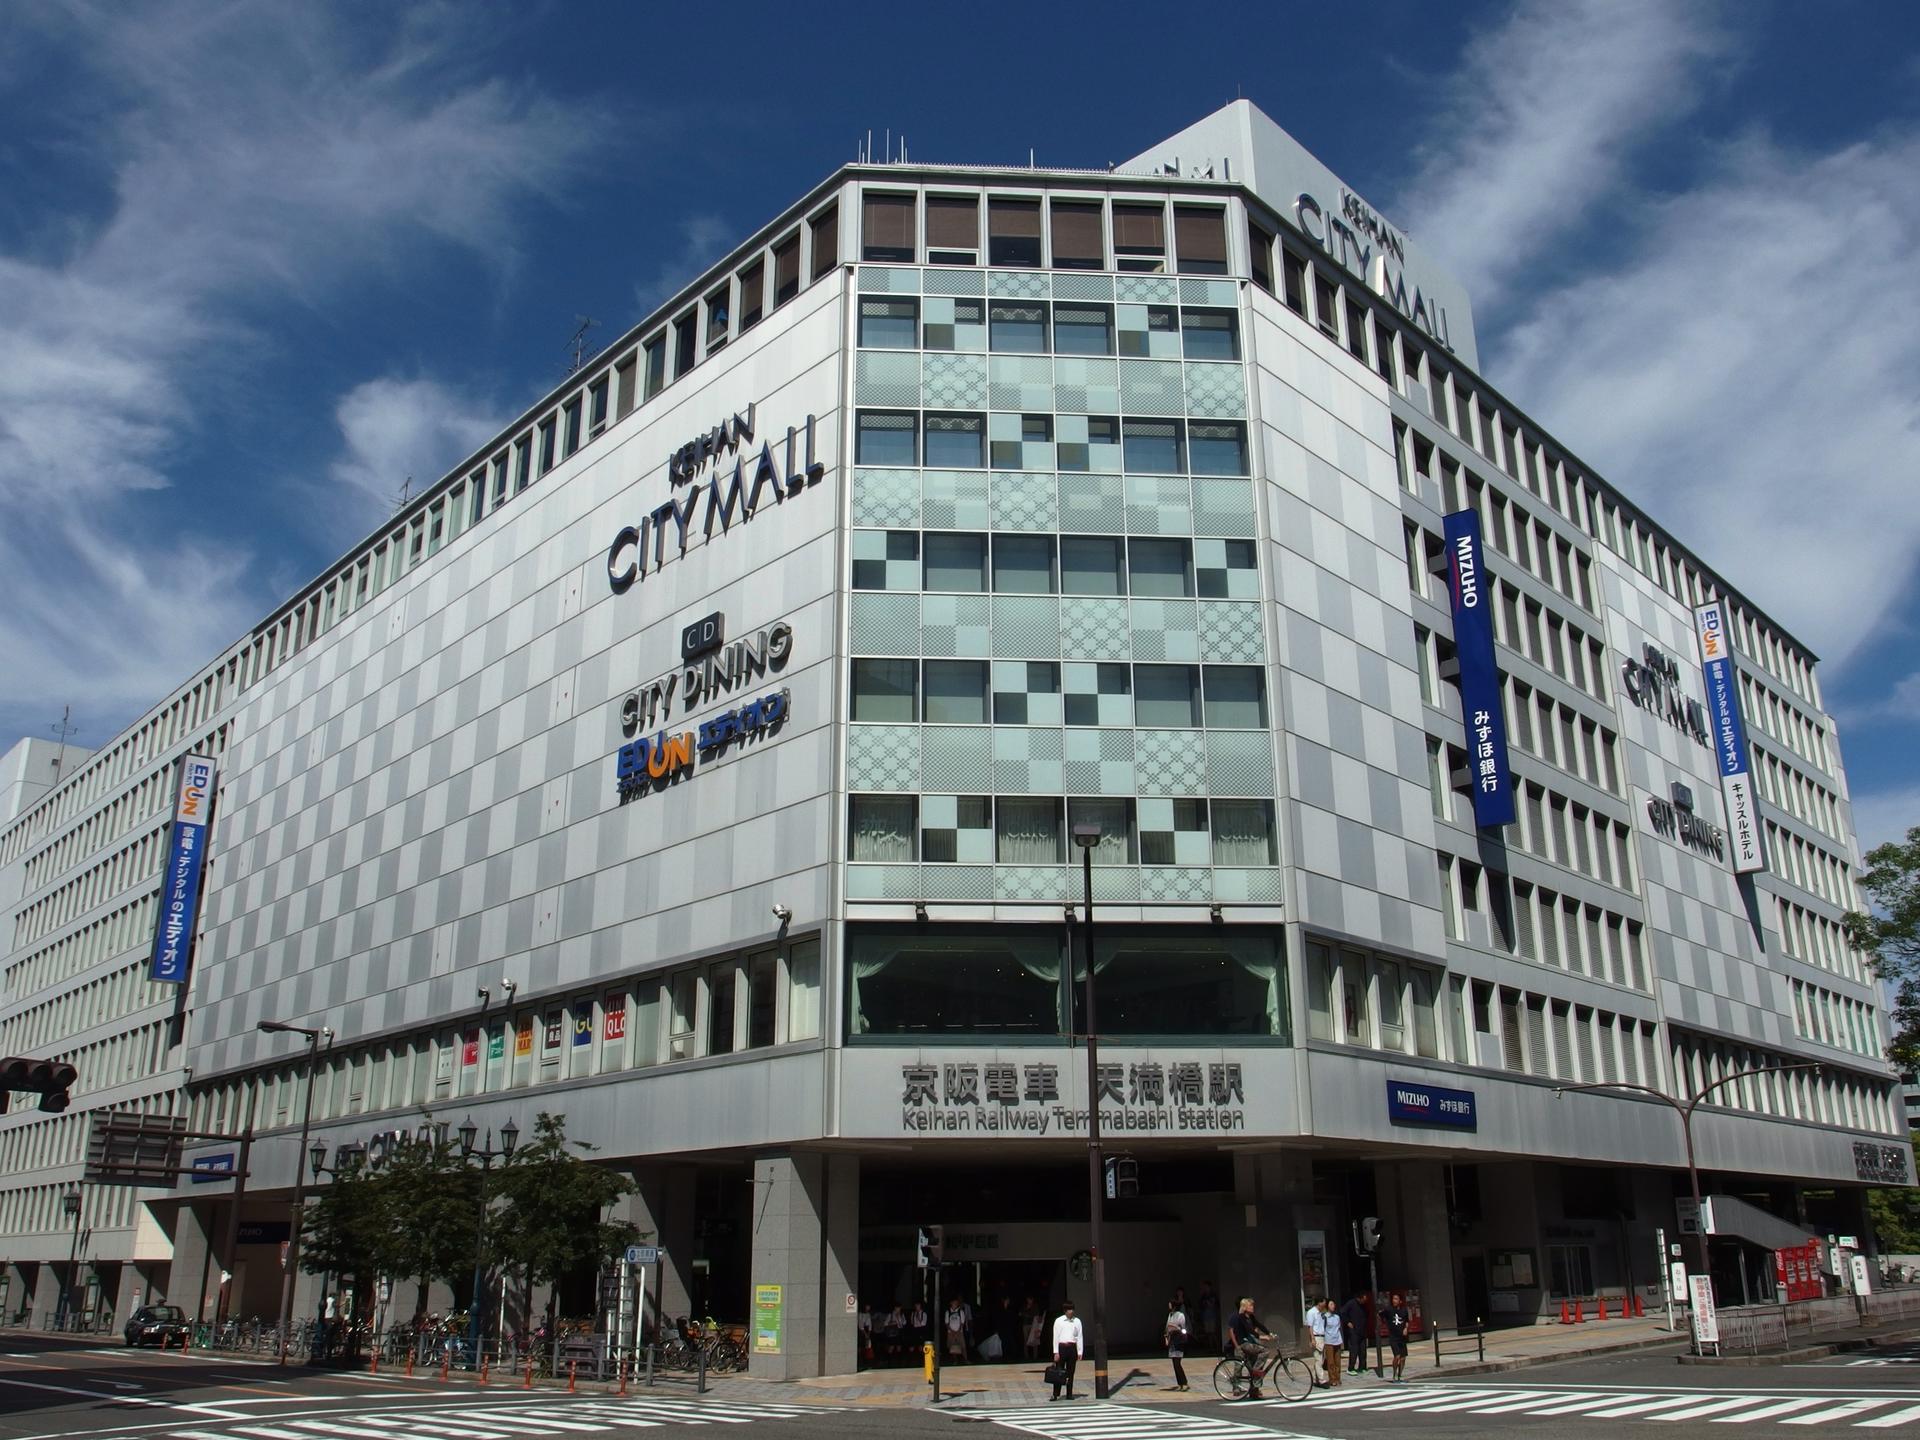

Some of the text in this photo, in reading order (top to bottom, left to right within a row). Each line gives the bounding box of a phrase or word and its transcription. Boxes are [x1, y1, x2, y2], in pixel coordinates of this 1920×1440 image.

[1295, 193, 1455, 353] CITY MALL
[608, 414, 824, 592] CITY MALL
[1456, 535, 1478, 608] MIZUHO
[620, 621, 792, 728] CITY DINING
[1474, 710, 1498, 793] みずほ銀行
[1732, 783, 1754, 860] キャッスルホテル
[902, 1062, 1245, 1103] 京阪電車 天満橋駅
[902, 1106, 970, 1131] Keihan
[975, 1105, 1050, 1135] Railway
[1177, 1105, 1245, 1131] Station
[1397, 1090, 1430, 1107] MIZUHO
[1439, 1099, 1470, 1114] みずほ銀行
